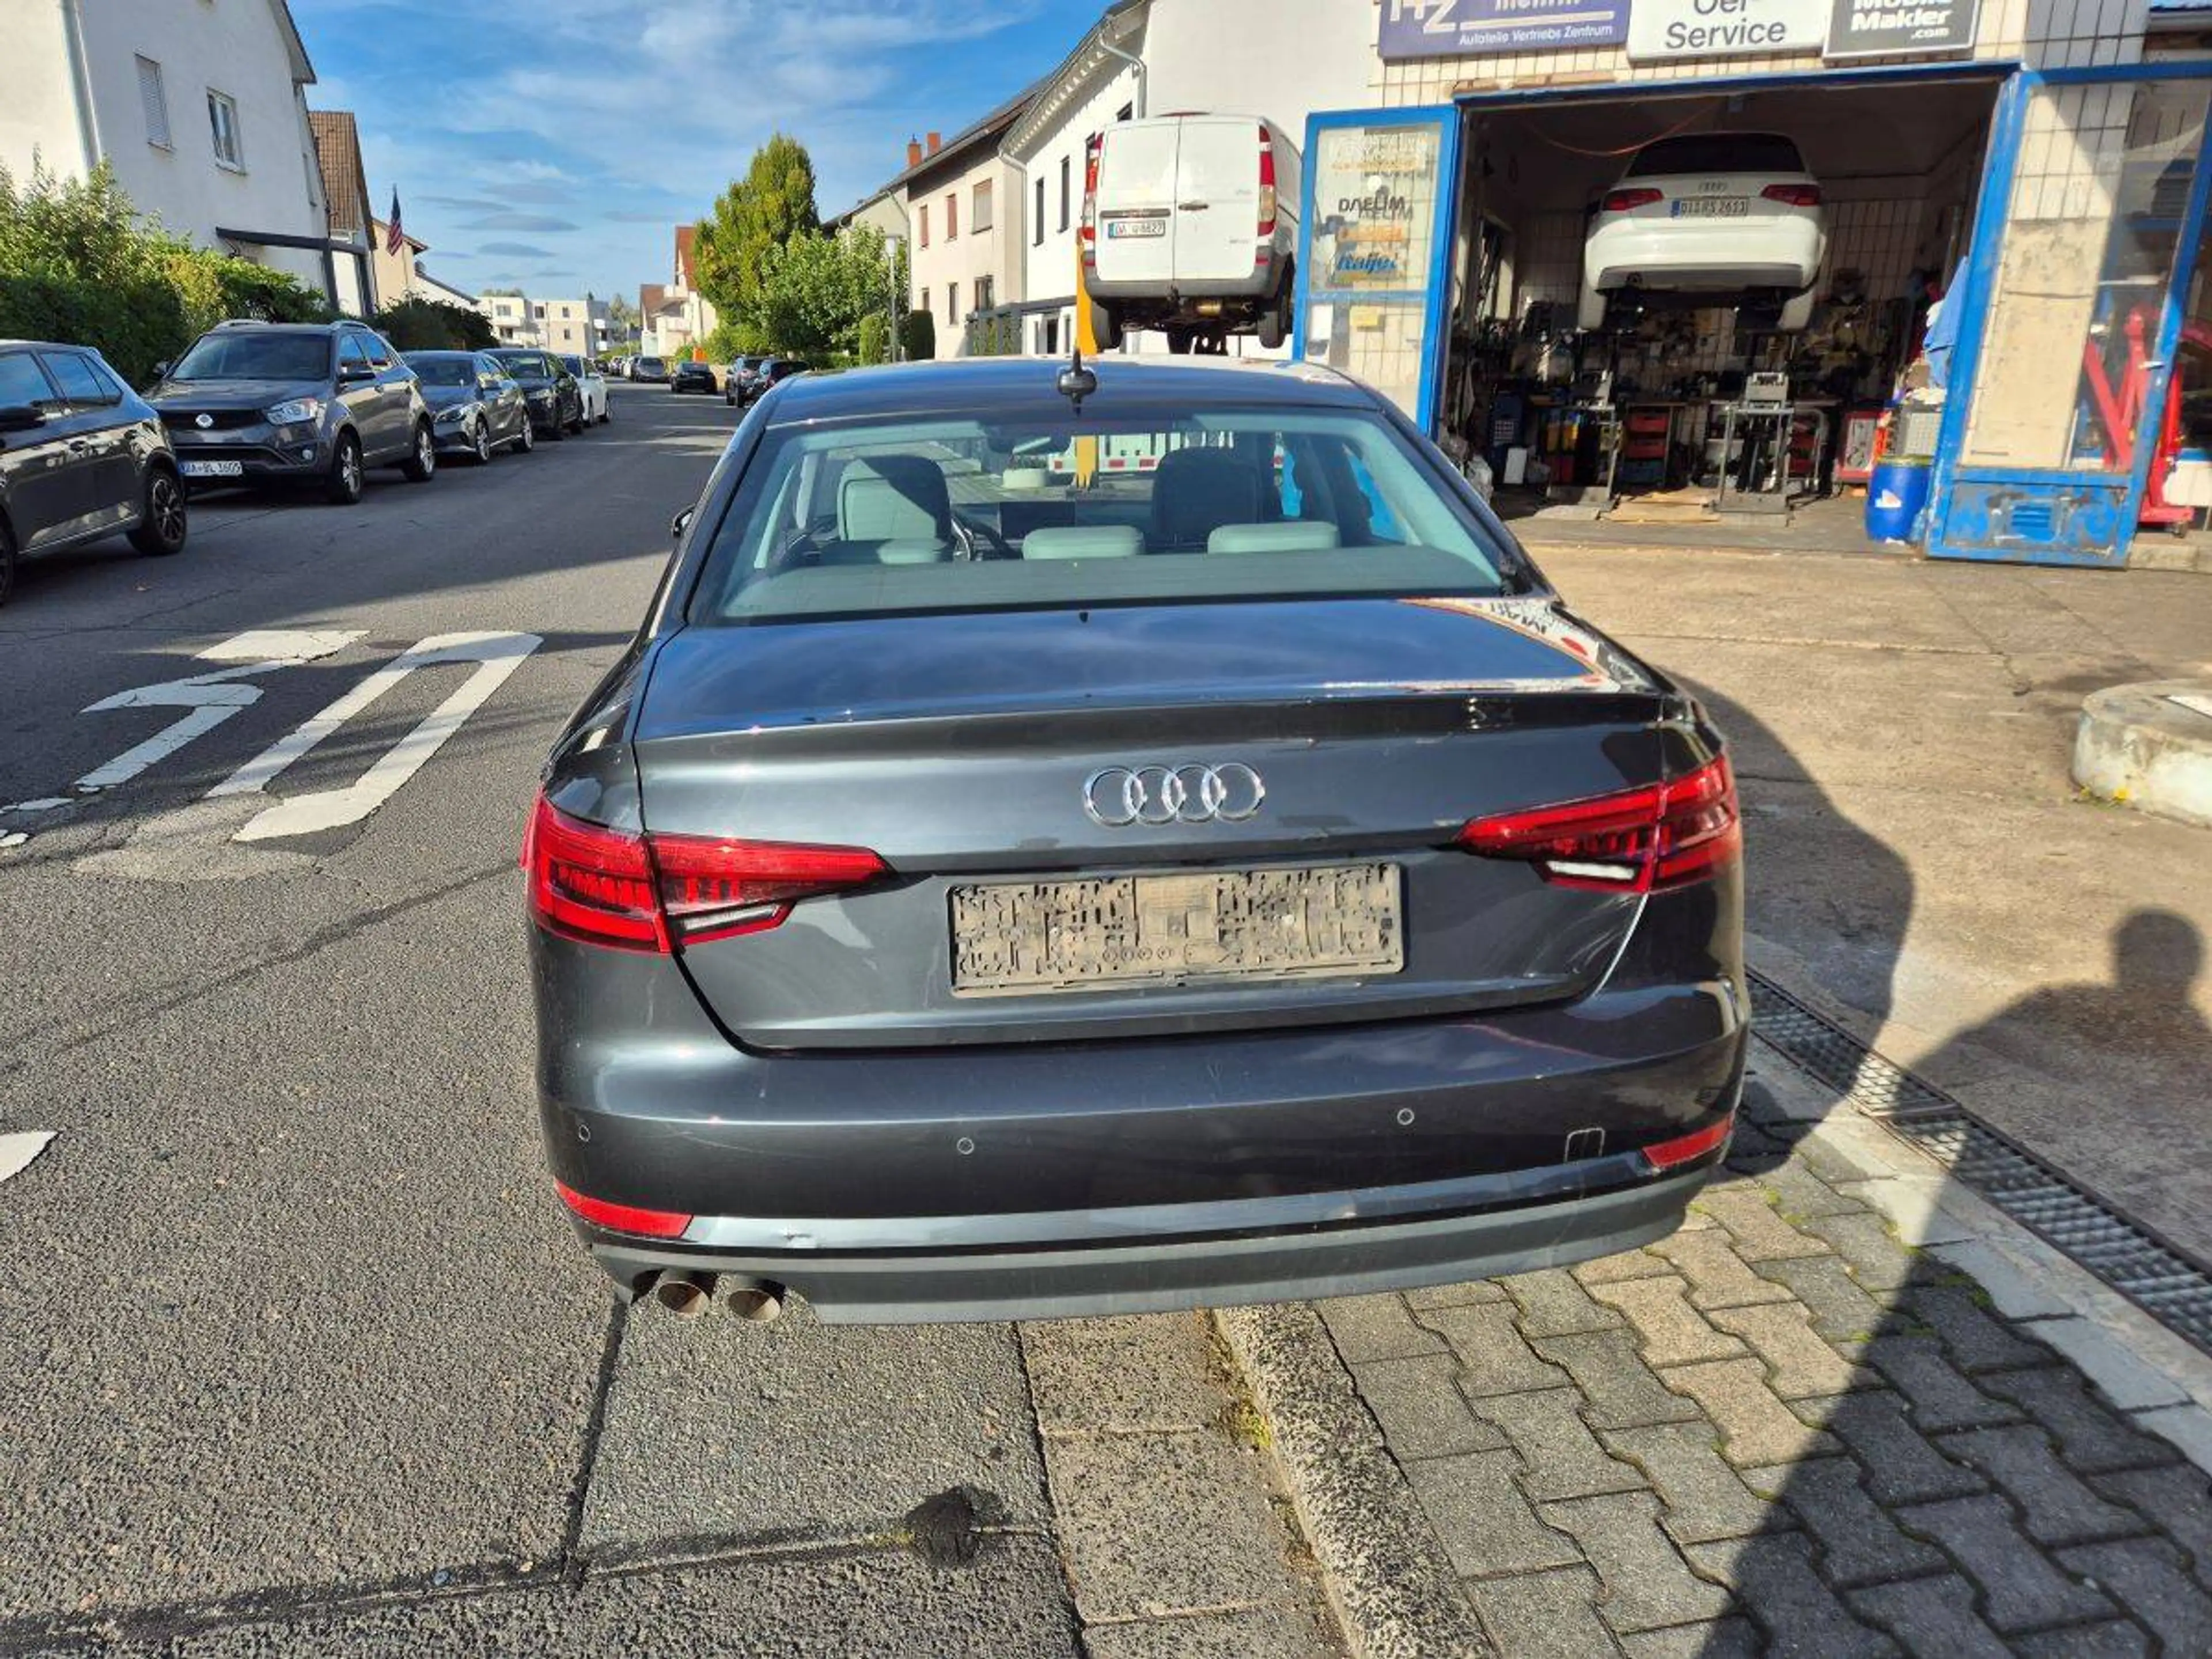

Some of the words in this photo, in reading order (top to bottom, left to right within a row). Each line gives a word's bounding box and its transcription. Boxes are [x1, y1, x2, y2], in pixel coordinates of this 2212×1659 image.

[1851, 8, 1953, 31] Makler
[1459, 32, 1509, 46] Autoteile
[1513, 29, 1562, 42] Vertriebs
[1564, 24, 1613, 39] Zentrum
[1665, 18, 1786, 49] Service
